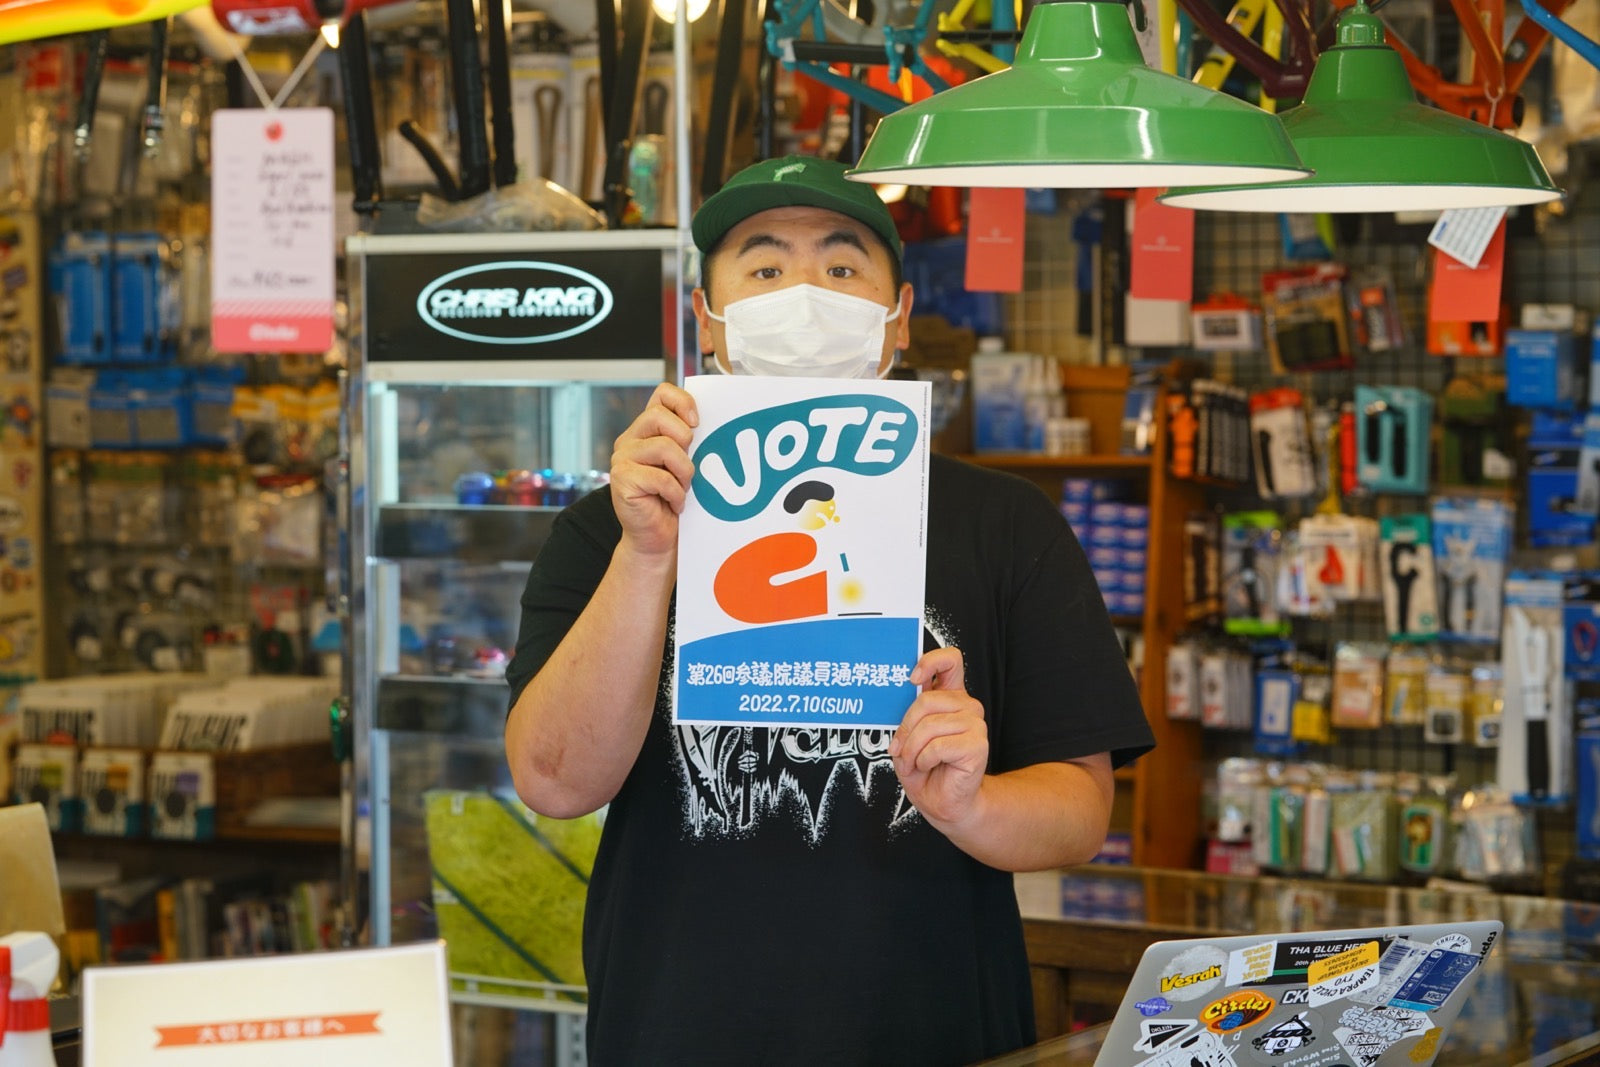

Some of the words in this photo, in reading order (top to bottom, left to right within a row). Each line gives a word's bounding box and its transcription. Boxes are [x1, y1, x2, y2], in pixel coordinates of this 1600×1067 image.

[430, 288, 519, 309] CHRIS
[522, 287, 596, 307] KING
[432, 307, 502, 318] PRECISION
[508, 305, 595, 317] COMPONENTS
[700, 407, 907, 506] VOTE
[687, 660, 910, 687] 第26回参議院議員通常選挙
[739, 694, 863, 715] 2022.7.10(SUN)
[1289, 946, 1310, 955] THA
[1313, 944, 1342, 953] BLUE
[1160, 964, 1222, 993] Vesrah
[1334, 973, 1354, 987] TYO
[1340, 968, 1375, 995] TEMPRA
[1312, 984, 1338, 998] CYCLE
[1203, 997, 1271, 1021] Circles
[197, 1018, 345, 1043] 大切なお客様へ
